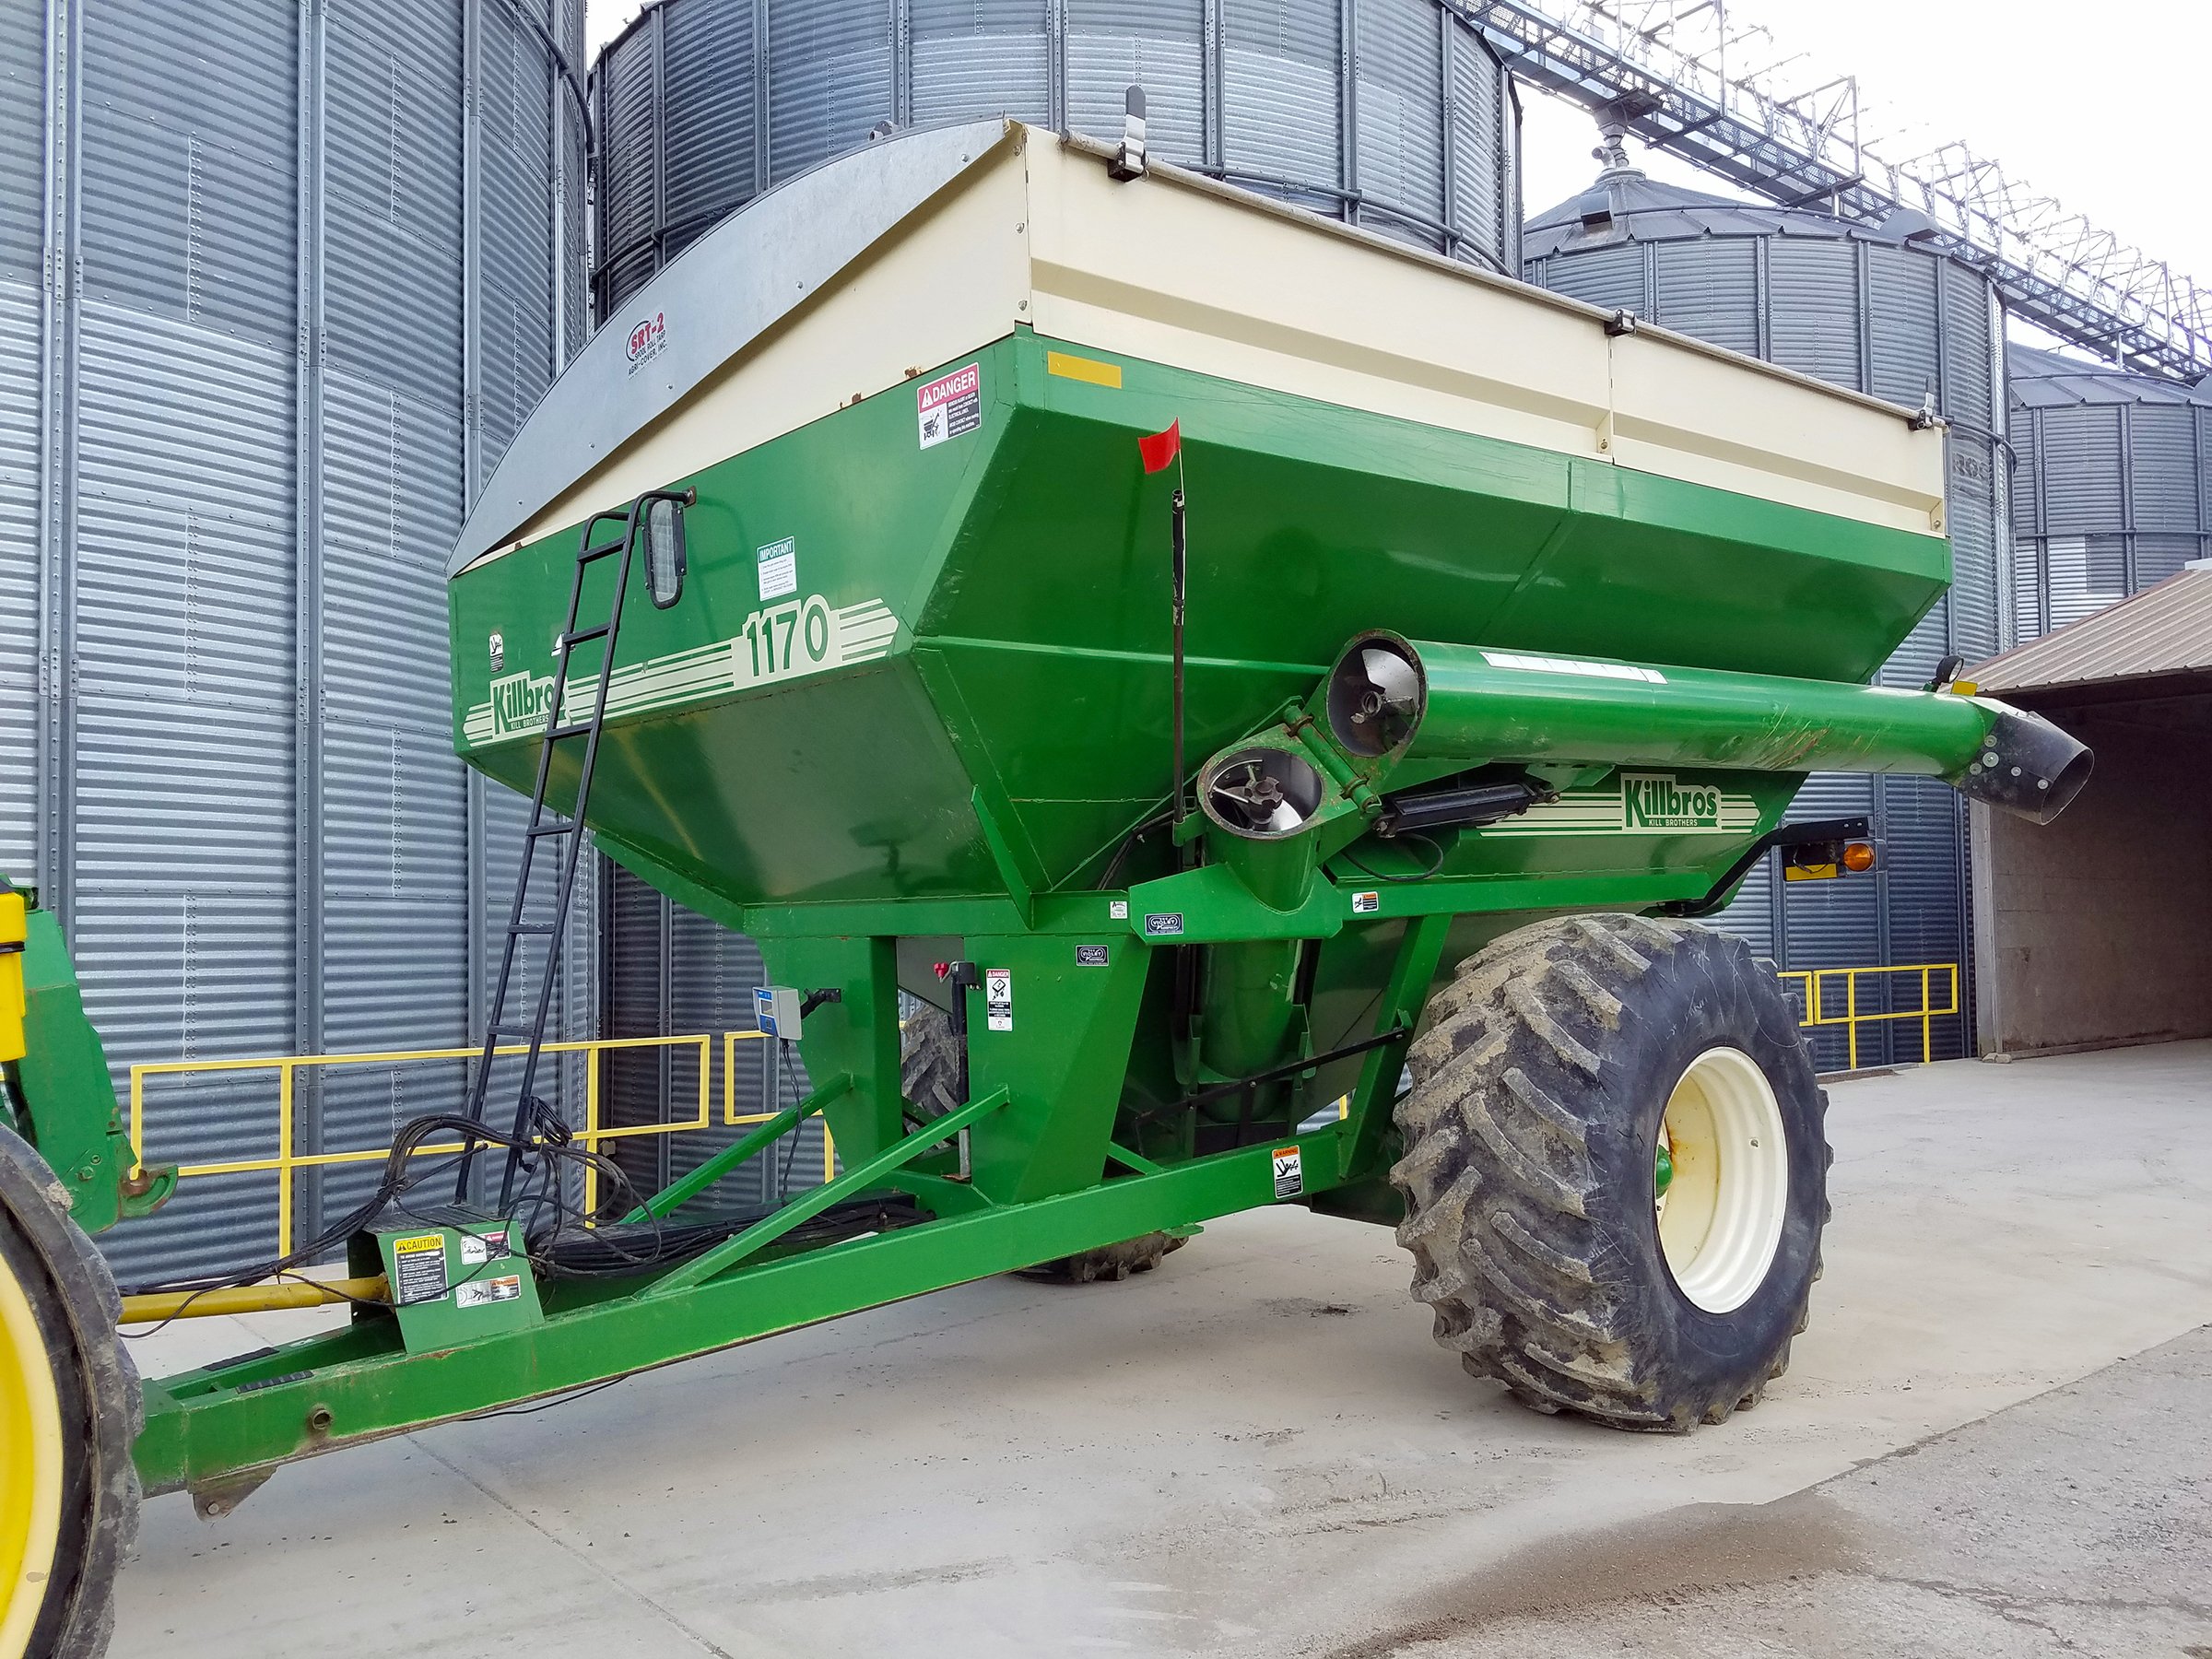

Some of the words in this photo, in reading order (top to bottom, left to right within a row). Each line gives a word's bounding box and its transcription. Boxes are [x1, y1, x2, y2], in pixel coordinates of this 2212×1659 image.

[631, 312, 665, 355] SRT-2
[932, 371, 976, 403] DANGER
[759, 540, 793, 561] IMPORTANT
[747, 604, 829, 677] 1170
[493, 678, 565, 735] Killbro
[510, 722, 522, 730] KILL
[523, 714, 549, 727] BROTHERS
[1625, 780, 1718, 828] Killbros
[1665, 818, 1698, 827] BROTHERS
[406, 1237, 441, 1251] CAUTION
